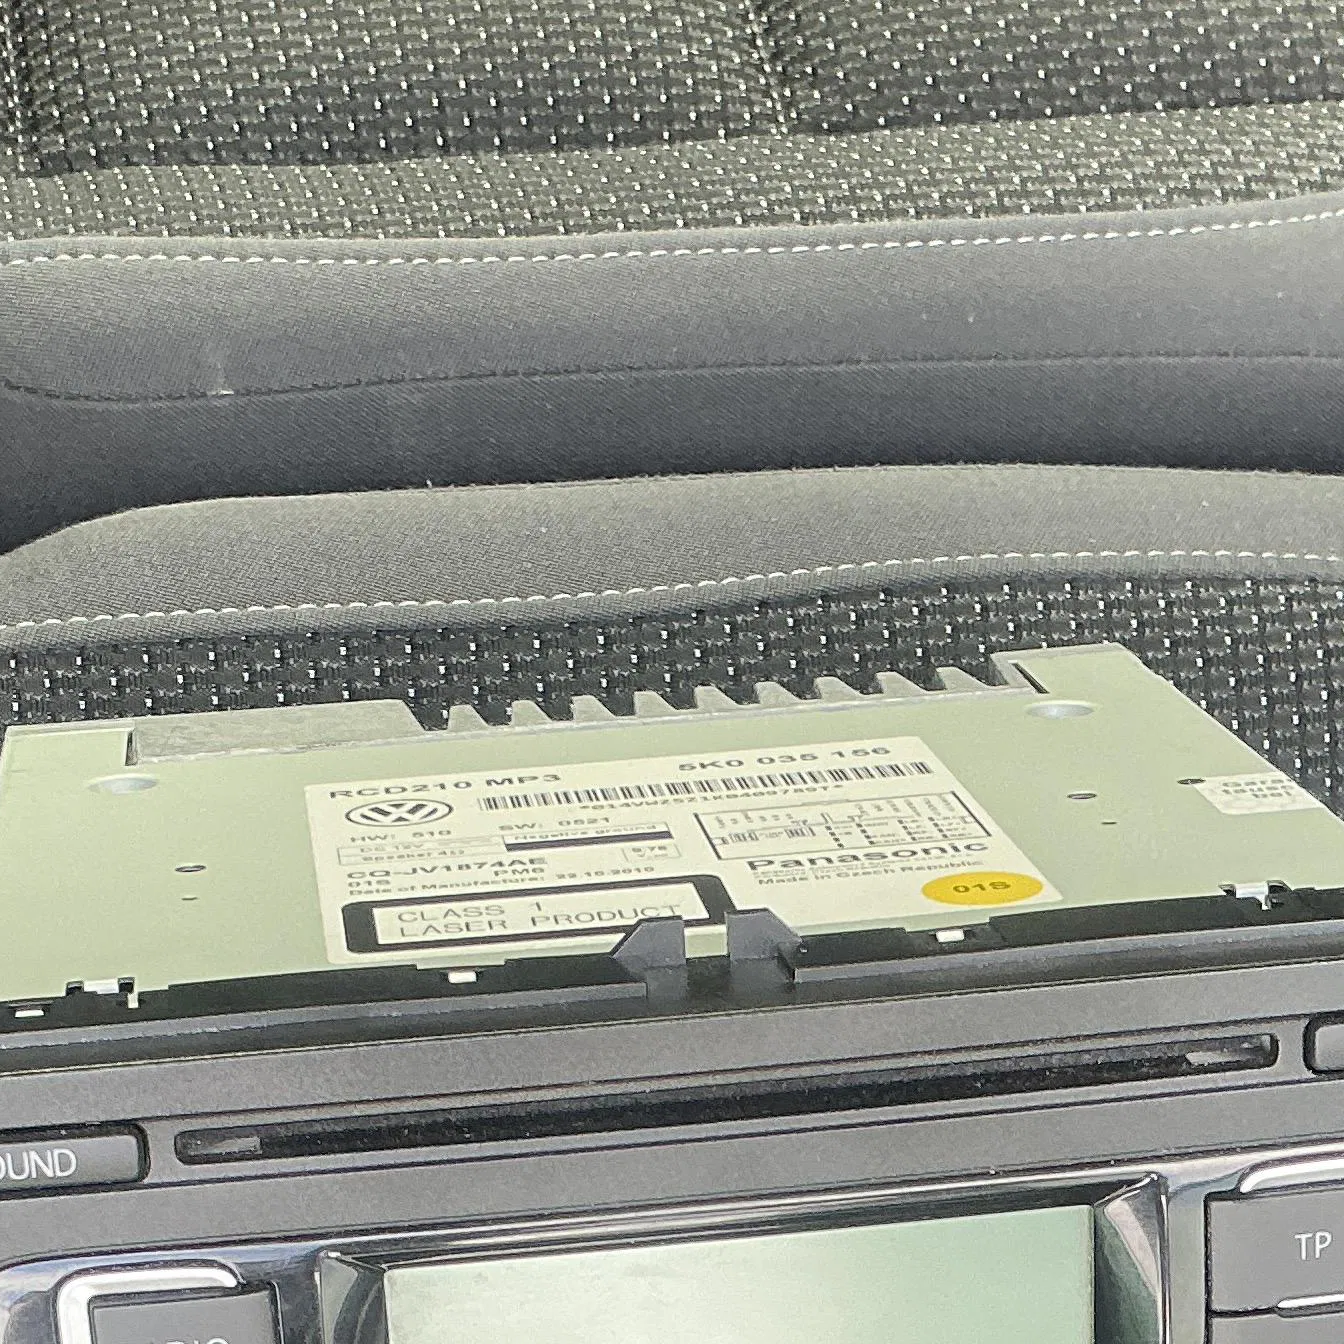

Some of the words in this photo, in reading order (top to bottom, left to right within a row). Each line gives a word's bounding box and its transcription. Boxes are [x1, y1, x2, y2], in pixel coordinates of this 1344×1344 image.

[678, 759, 745, 772] 5K0
[756, 753, 819, 765] 035
[830, 746, 892, 758] 156
[329, 780, 473, 800] RCD210
[485, 773, 562, 788] MP3
[745, 841, 990, 872] Panasonic
[758, 874, 807, 886] Made
[813, 871, 832, 881] in
[837, 865, 897, 879] Czech
[900, 858, 985, 875] Republic
[349, 887, 393, 896] Date
[951, 880, 1013, 895] 01S
[397, 904, 506, 923] CLASS
[398, 919, 509, 938] LASER
[529, 903, 681, 928] PRODUCT
[1295, 1230, 1334, 1261] TP
